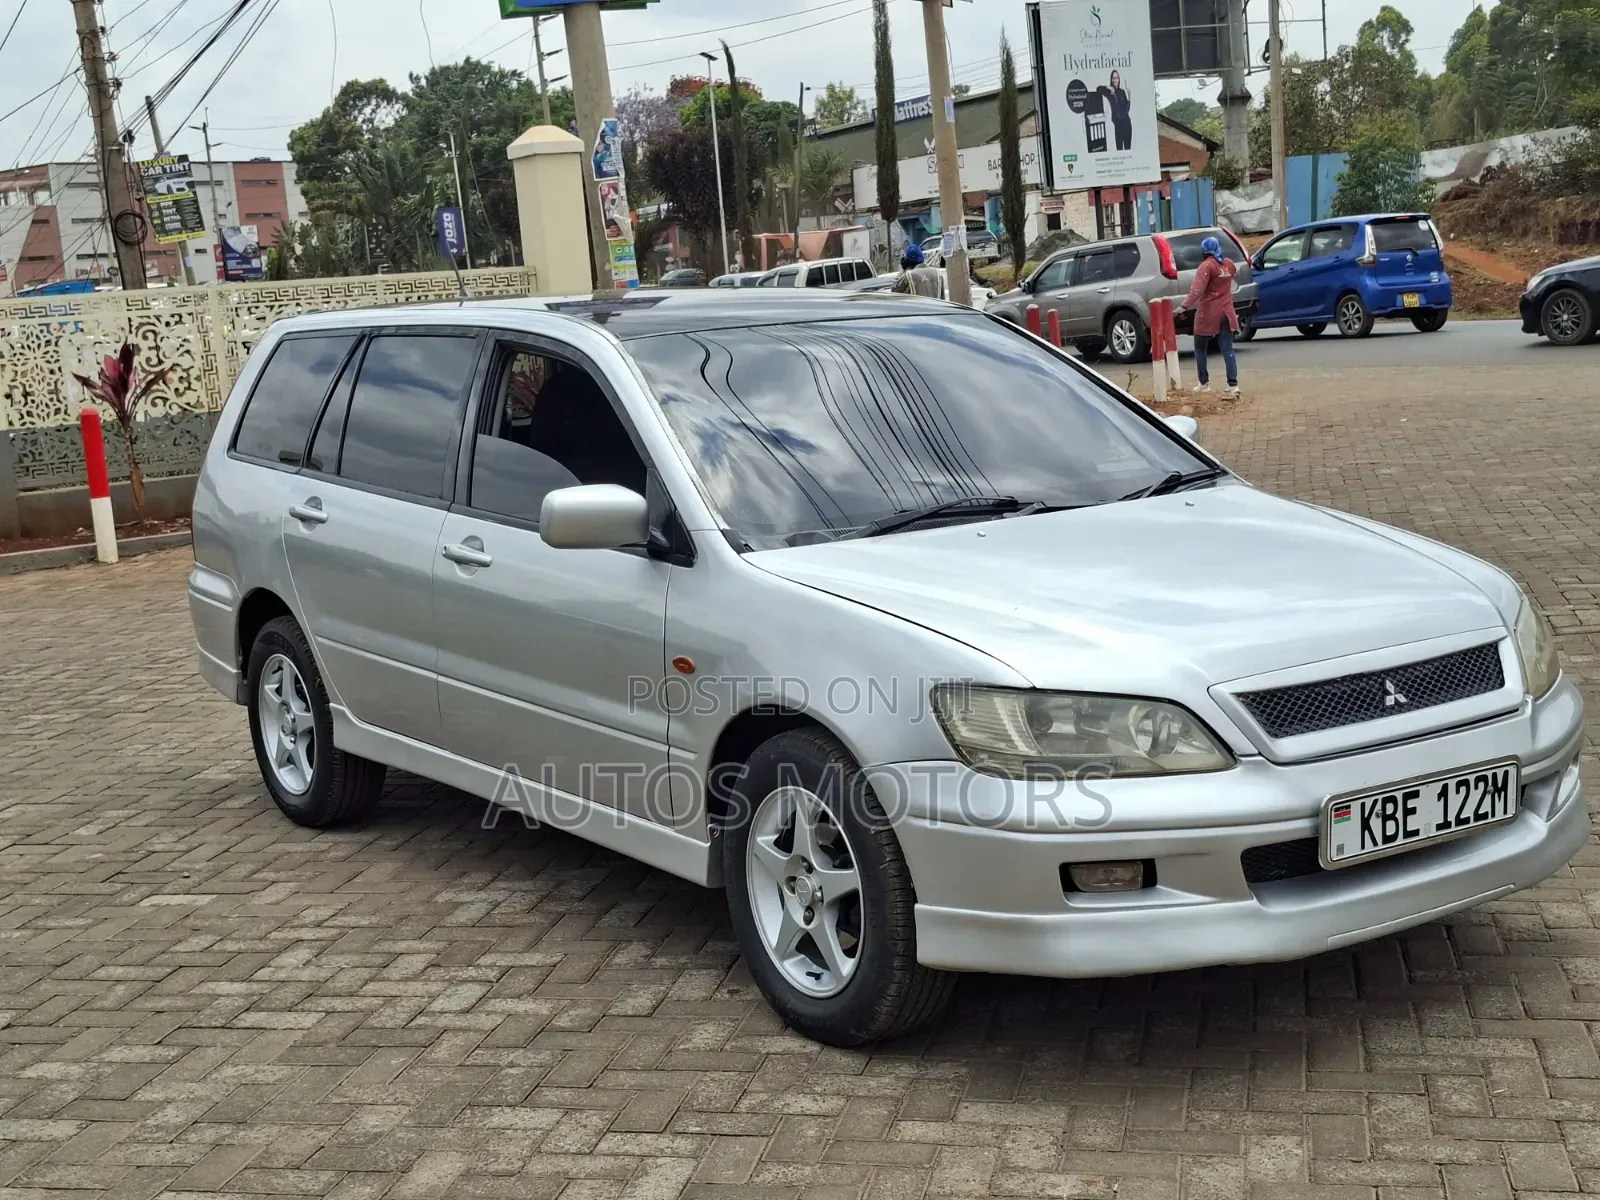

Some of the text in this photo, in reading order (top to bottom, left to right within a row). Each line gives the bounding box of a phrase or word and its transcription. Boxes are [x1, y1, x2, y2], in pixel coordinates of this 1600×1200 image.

[1063, 50, 1133, 75] Hydrafacial
[140, 156, 179, 168] LUXURY
[140, 161, 190, 176] CAR TINT
[443, 213, 457, 244] jaza
[1360, 769, 1509, 850] KBE 122M
